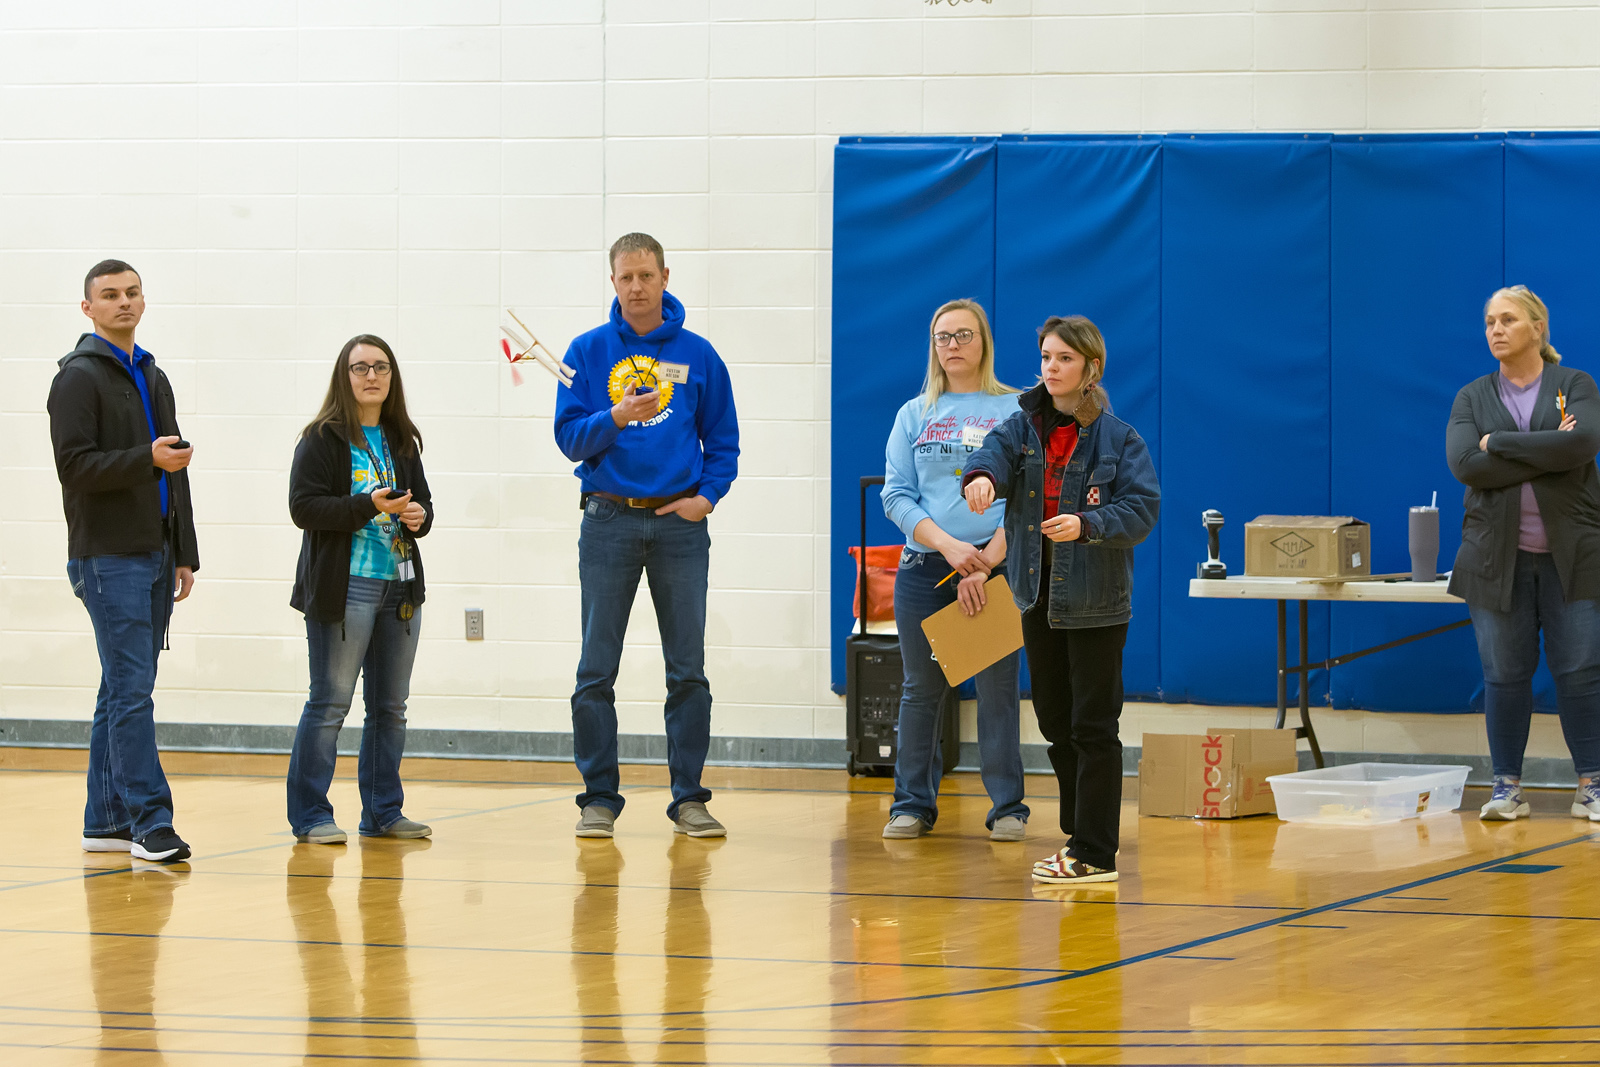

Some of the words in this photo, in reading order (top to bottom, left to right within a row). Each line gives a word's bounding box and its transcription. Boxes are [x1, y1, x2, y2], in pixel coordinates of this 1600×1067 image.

[963, 415, 999, 429] Platt
[920, 444, 932, 454] Ge
[940, 444, 952, 454] Ni
